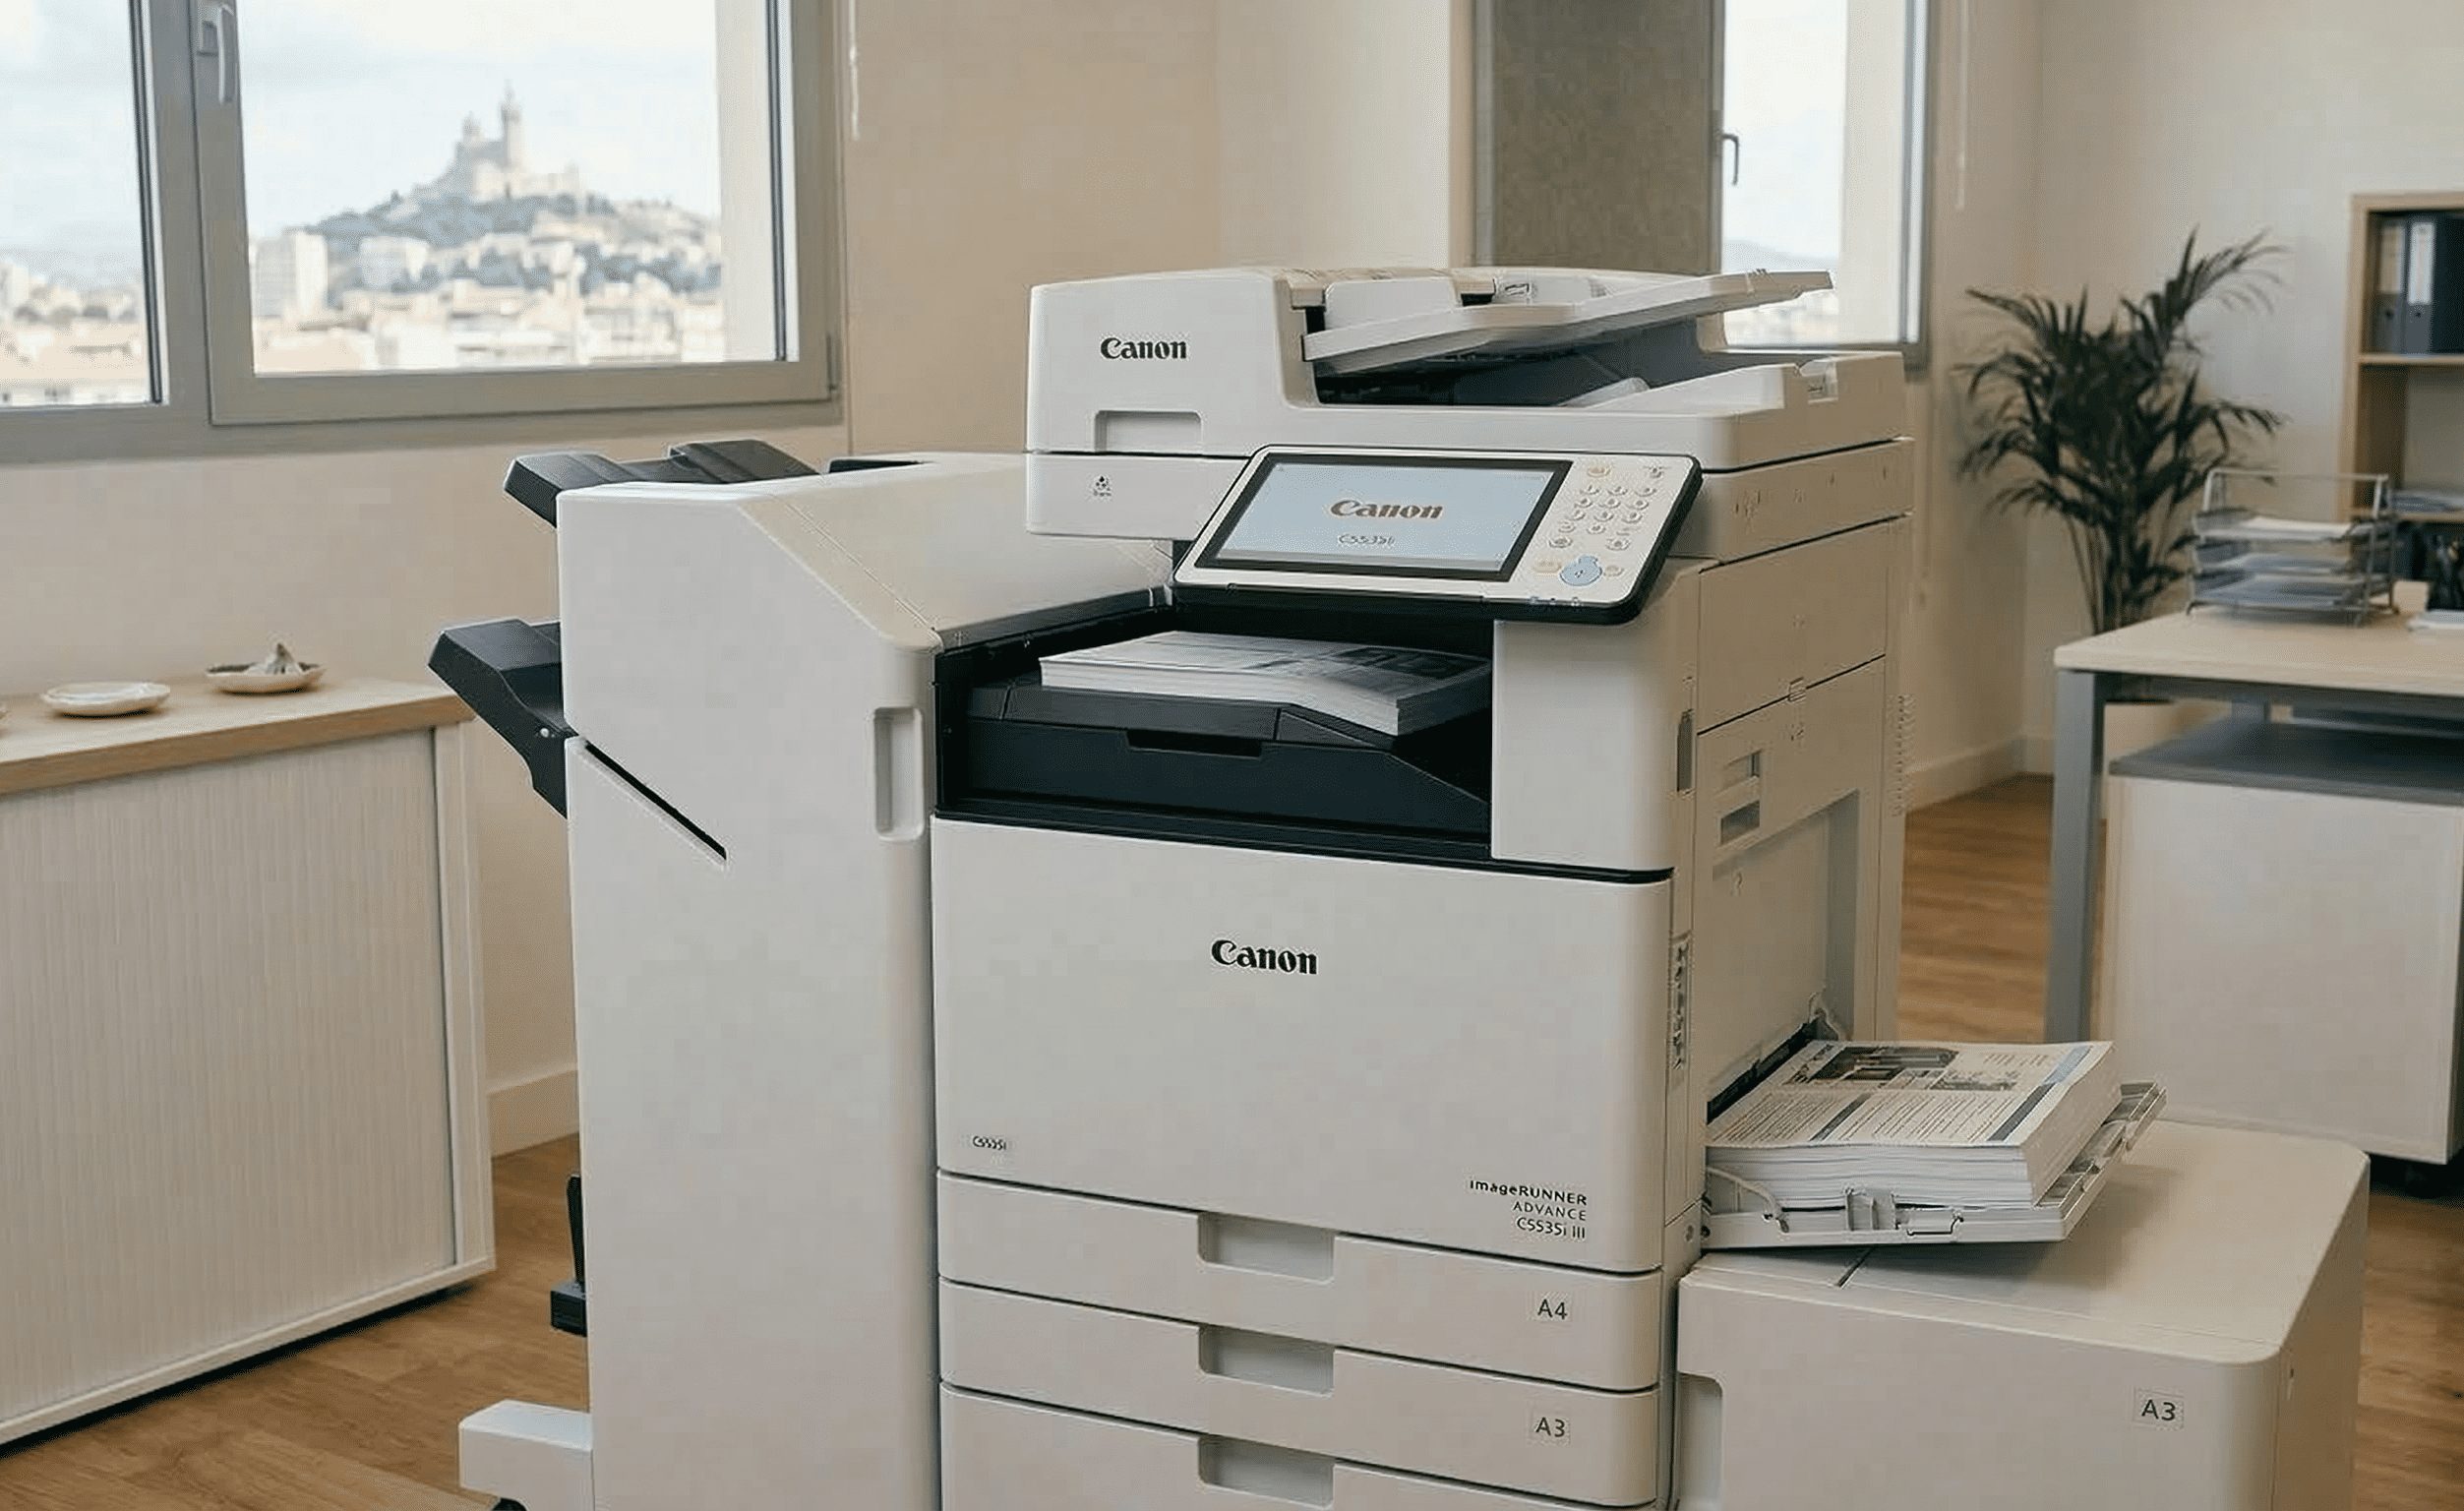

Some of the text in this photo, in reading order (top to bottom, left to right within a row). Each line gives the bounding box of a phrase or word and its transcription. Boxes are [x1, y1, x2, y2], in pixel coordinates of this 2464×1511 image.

[1101, 337, 1187, 359] Canon
[1331, 500, 1443, 518] Canon
[1211, 939, 1317, 974] Canon
[1470, 1179, 1587, 1206] imageRUNNER
[1513, 1201, 1587, 1221] ADVANCE
[1537, 1299, 1568, 1320] A4
[2141, 1399, 2176, 1421] A3
[1535, 1417, 1565, 1438] A3
